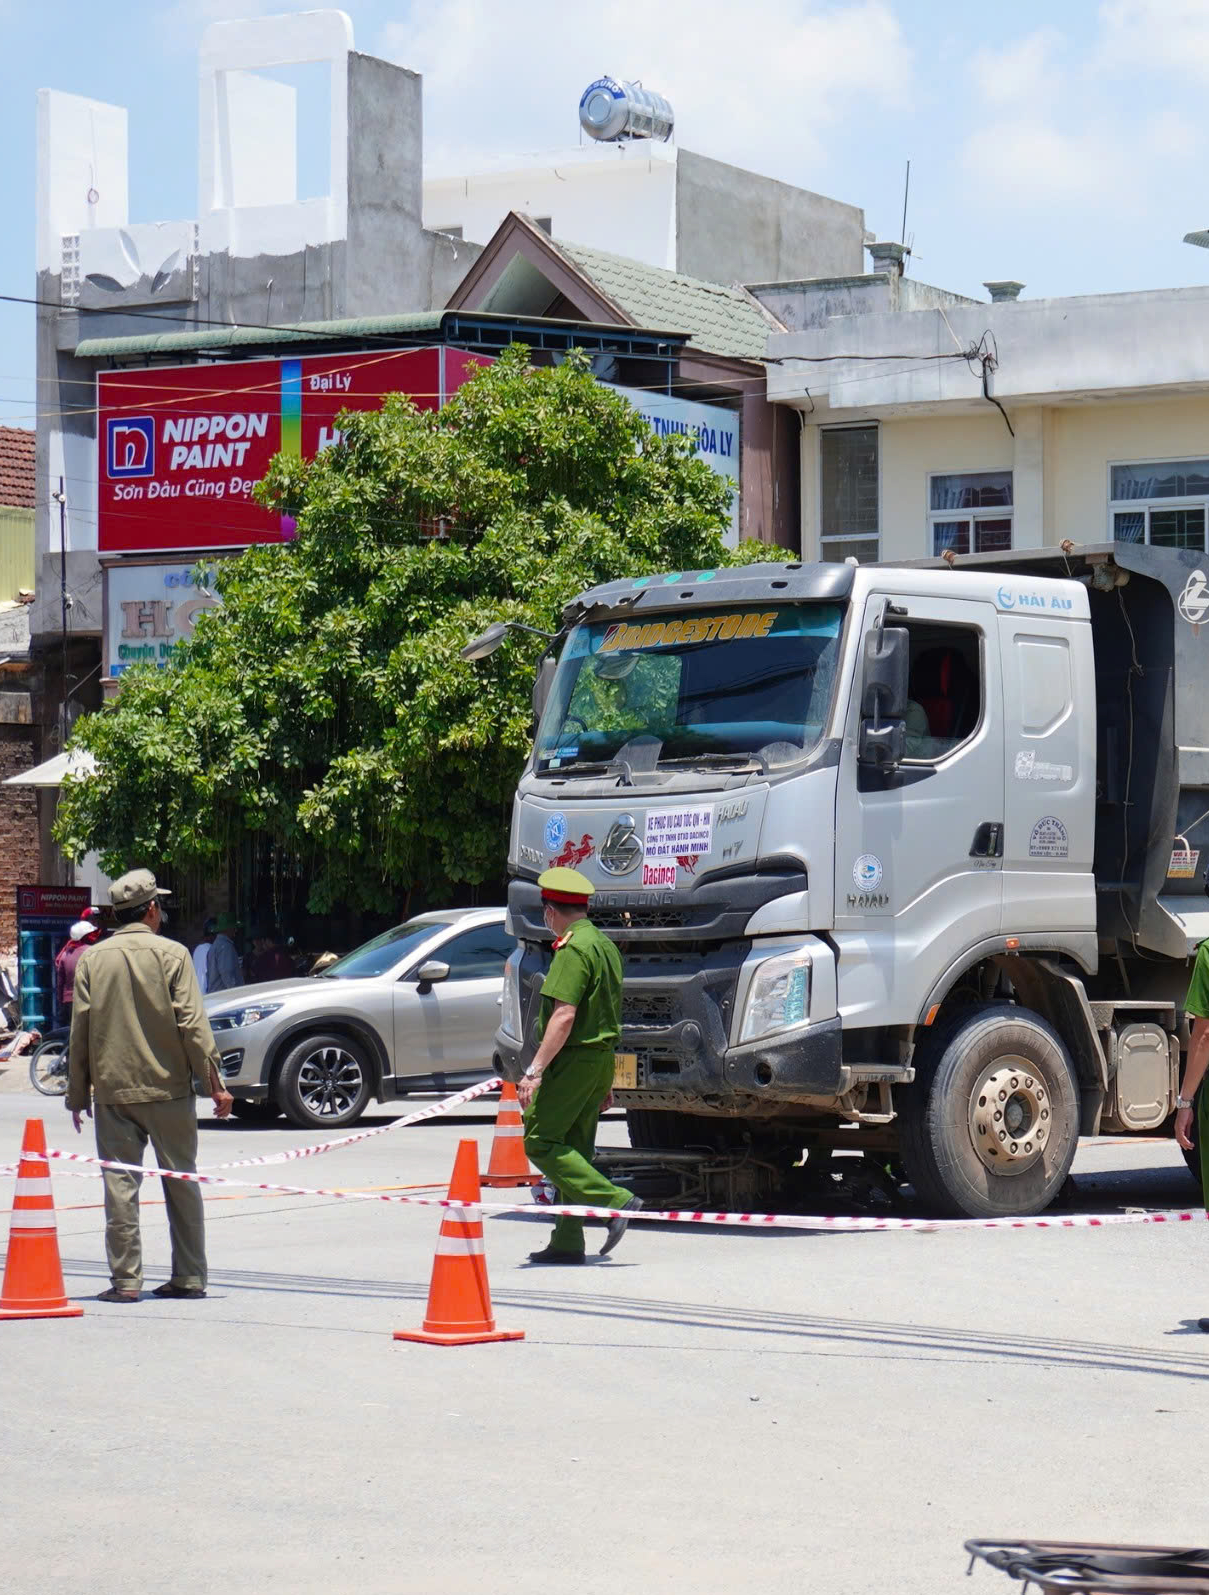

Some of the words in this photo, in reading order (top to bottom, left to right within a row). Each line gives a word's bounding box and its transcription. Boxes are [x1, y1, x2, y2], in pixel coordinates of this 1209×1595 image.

[310, 374, 333, 392] Đại
[336, 373, 352, 392] Lý
[163, 413, 268, 443] NIPPON
[720, 431, 733, 457] LY
[170, 442, 251, 470] PAINT
[113, 483, 143, 500] Sơn
[148, 480, 180, 499] Đâu
[185, 478, 225, 499] Cũng
[1019, 591, 1045, 607] HẢI
[1051, 596, 1072, 609] ÂU
[597, 612, 779, 653] BRIDGESTONE
[674, 814, 682, 828] CAO
[659, 834, 664, 842] TY
[691, 842, 708, 852] MINH
[643, 864, 675, 885] Dacinco
